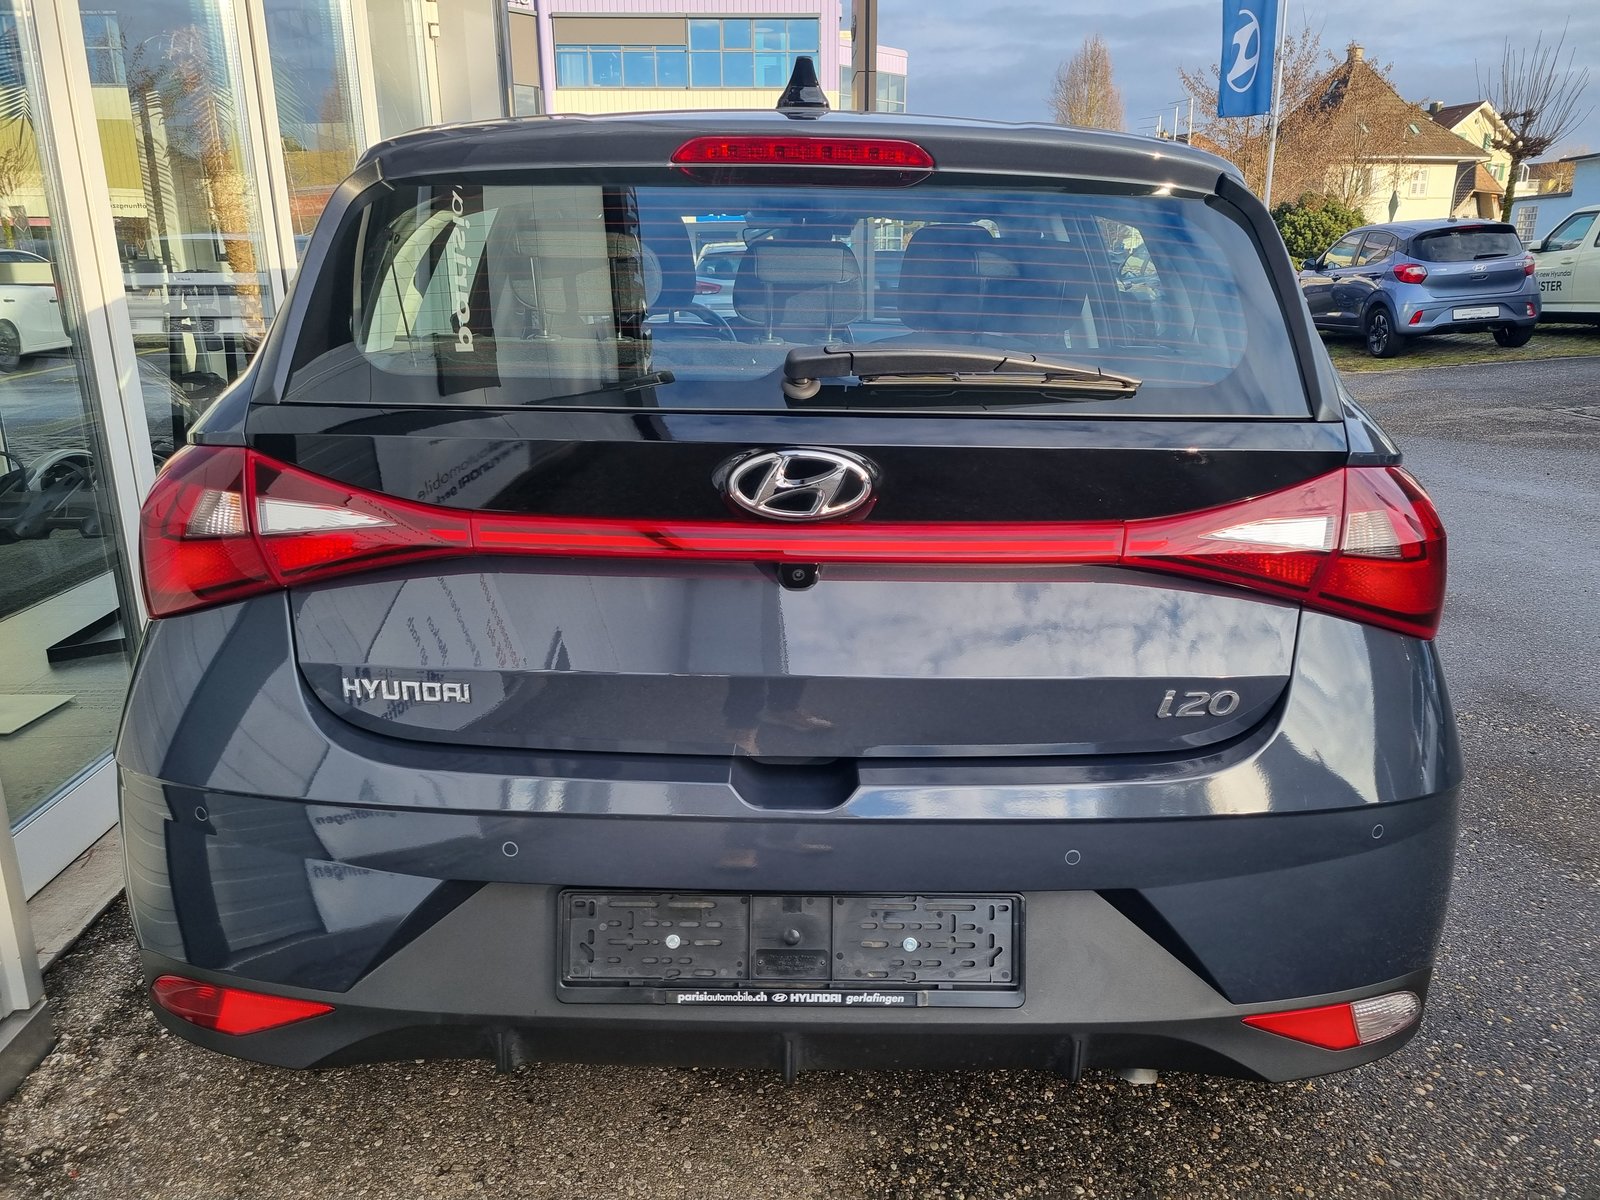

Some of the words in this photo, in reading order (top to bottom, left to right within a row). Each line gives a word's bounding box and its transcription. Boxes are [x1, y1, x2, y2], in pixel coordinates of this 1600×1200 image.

[1538, 280, 1562, 292] STER
[342, 677, 471, 704] HYUNDAI
[1157, 689, 1240, 719] i20
[677, 991, 768, 1004] parisiautomobile.ch
[789, 993, 842, 1003] HYUNDAI
[846, 992, 905, 1005] gerlafingen
